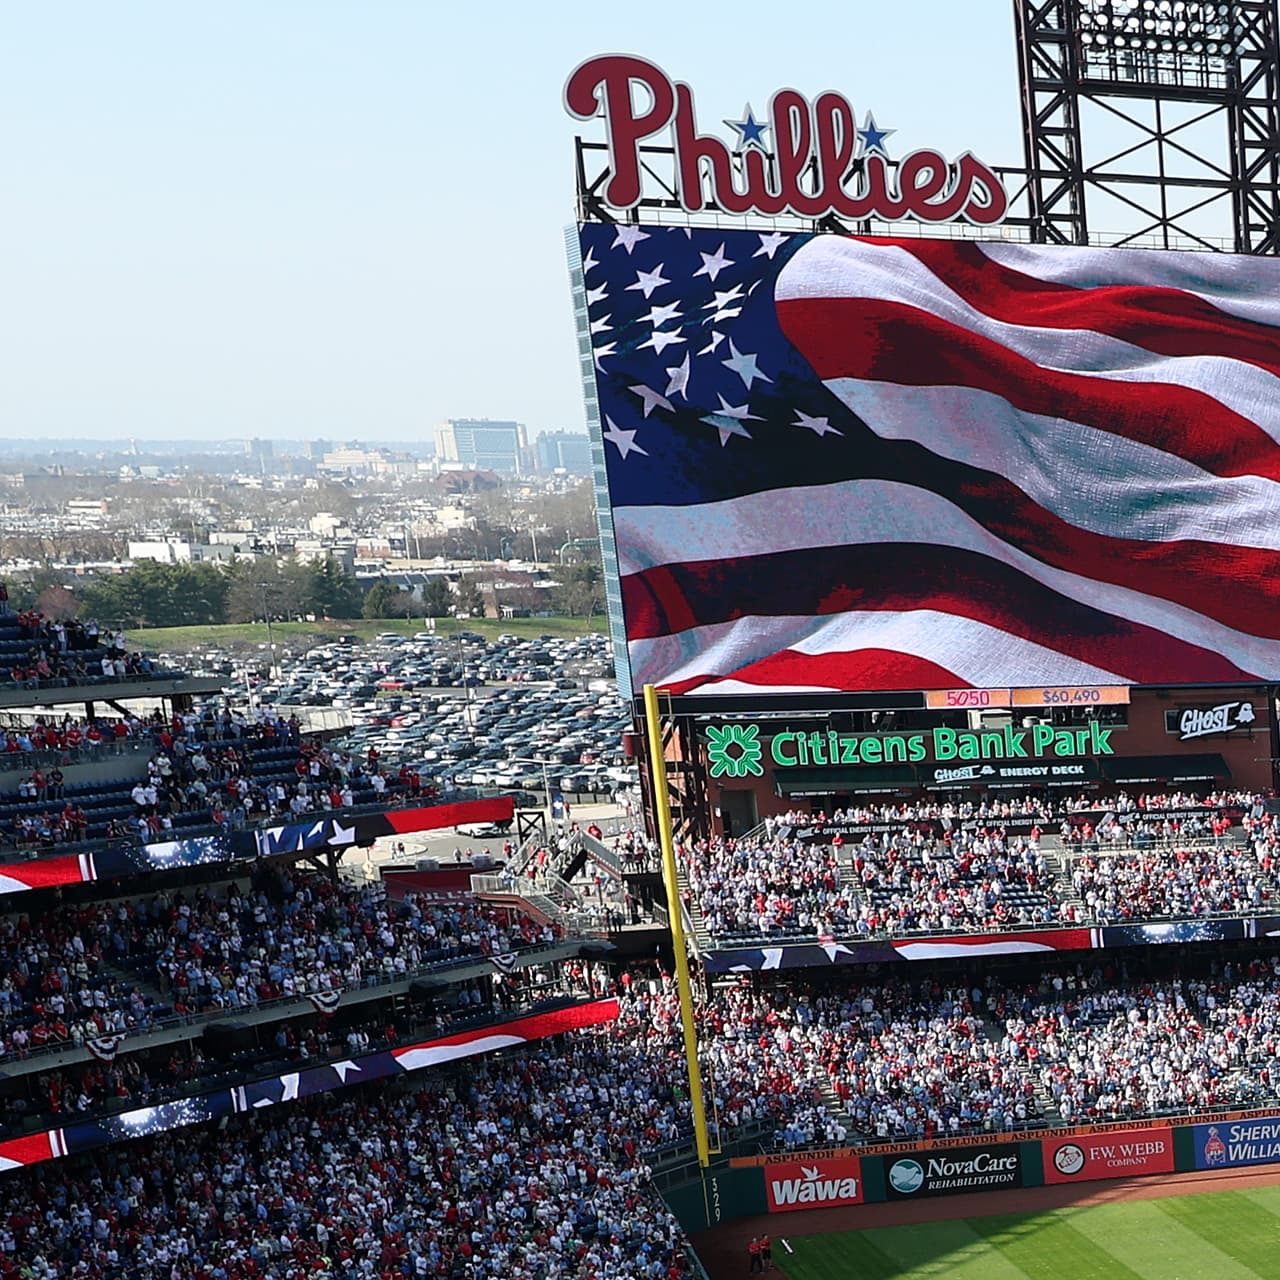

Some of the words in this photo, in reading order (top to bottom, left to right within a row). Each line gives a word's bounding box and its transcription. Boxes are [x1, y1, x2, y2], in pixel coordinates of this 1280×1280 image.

[562, 52, 1009, 226] Phillies
[1043, 690, 1100, 704] $60,490
[1180, 702, 1240, 741] GHOST
[771, 730, 926, 766] Citizens
[933, 724, 1028, 761] Bank
[1033, 721, 1114, 757] Park
[1000, 766, 1049, 777] ENERGY
[1052, 765, 1085, 775] DECK
[765, 1151, 834, 1164] ASPLUNDH
[849, 1143, 918, 1156] ASPLUNDH
[931, 1134, 998, 1148] ASPLUNDH
[1011, 1126, 1076, 1139] ASPLUNDH
[1089, 1120, 1152, 1133] ASPLUNDH
[1165, 1114, 1227, 1126] ASPLUNDH
[1090, 1145, 1116, 1160] F.W.
[1121, 1141, 1165, 1158] WEBB
[926, 1152, 1017, 1178] NovaCare
[1107, 1156, 1147, 1168] COMPANY
[772, 1178, 856, 1205] Wawa
[928, 1172, 1014, 1190] REHABILITATION
[712, 1177, 721, 1221] 329
